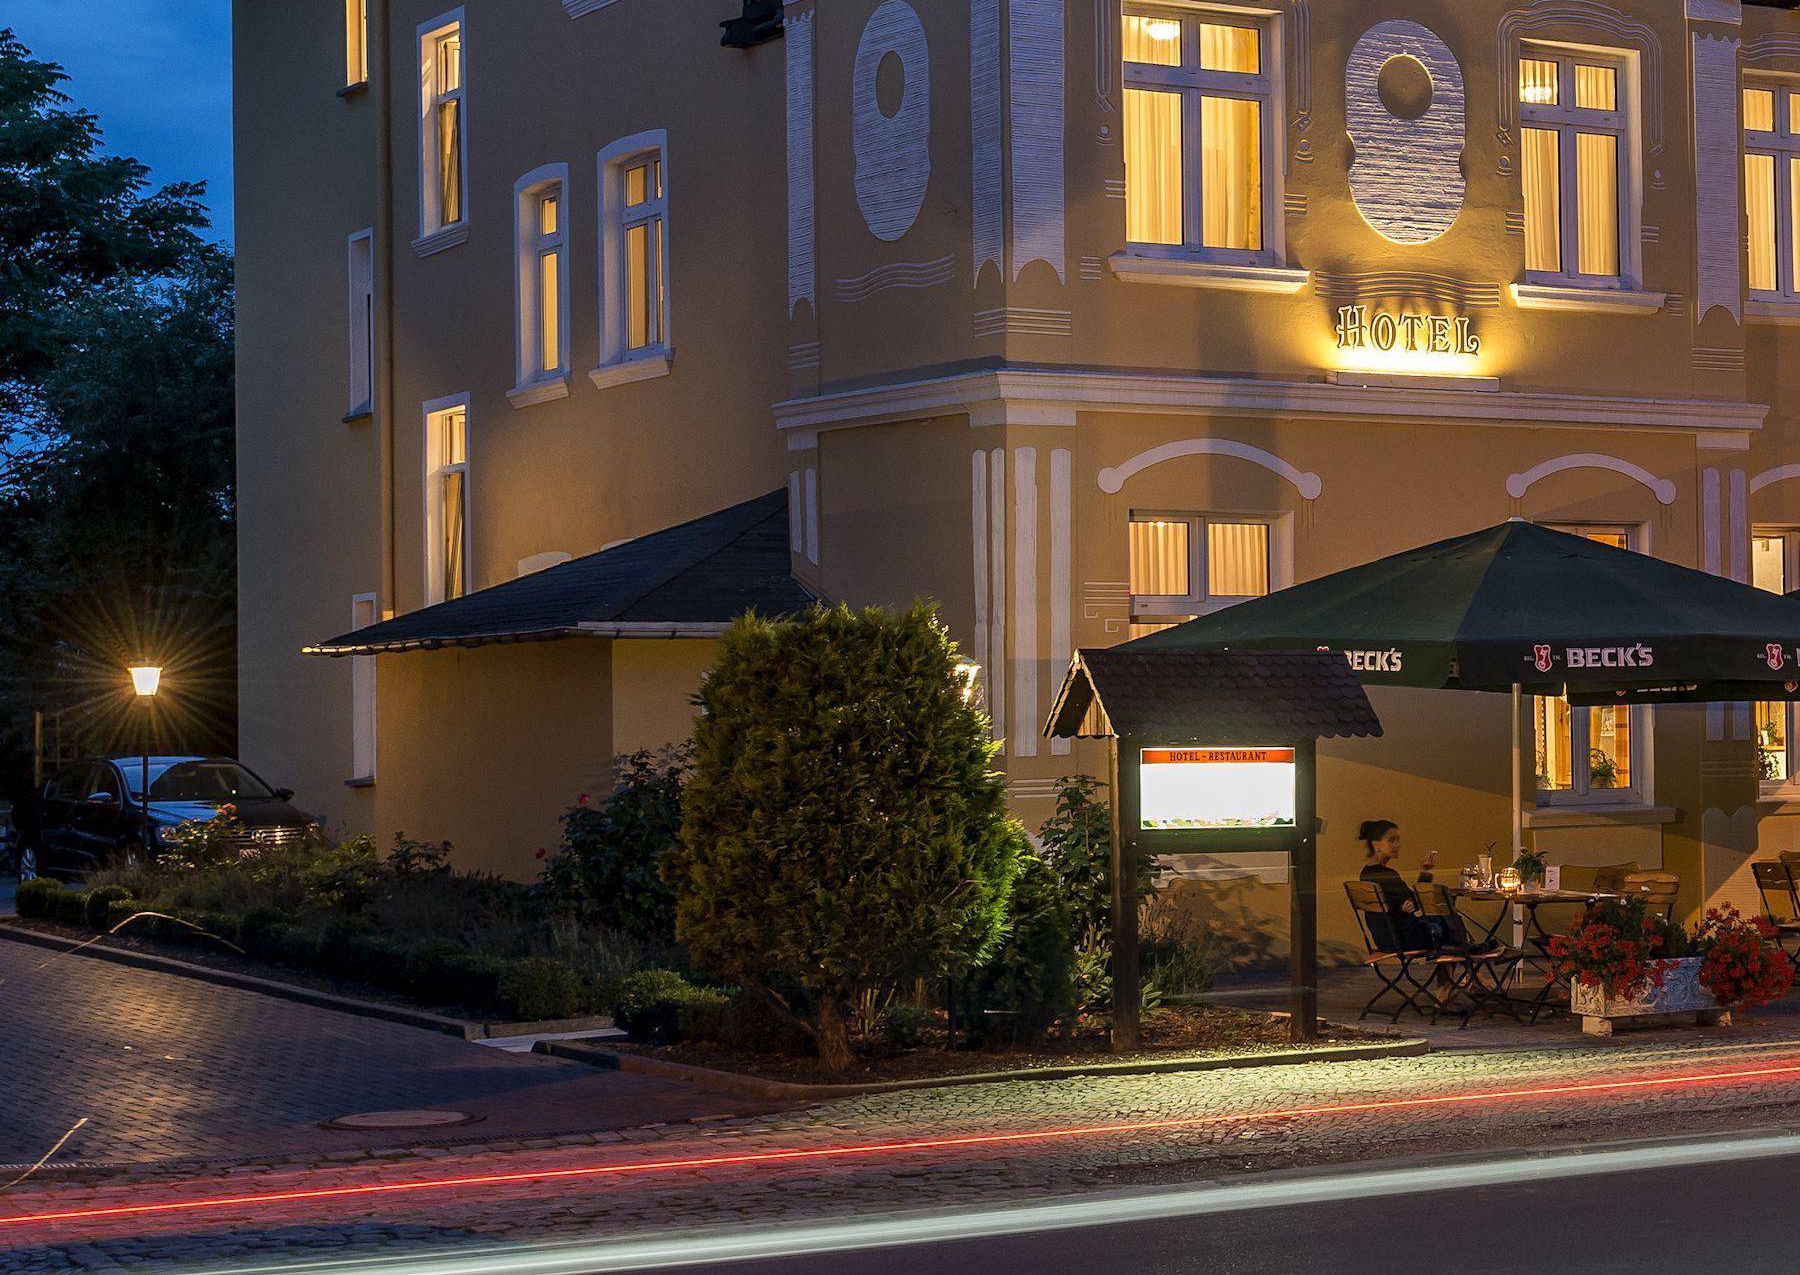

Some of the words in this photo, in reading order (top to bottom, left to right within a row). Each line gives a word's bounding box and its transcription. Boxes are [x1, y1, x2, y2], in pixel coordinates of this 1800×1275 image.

[1334, 304, 1481, 356] HOTEL
[1566, 643, 1654, 668] BECK'S
[1169, 751, 1200, 762] HOTEL
[1208, 750, 1267, 761] RESTAURANT
